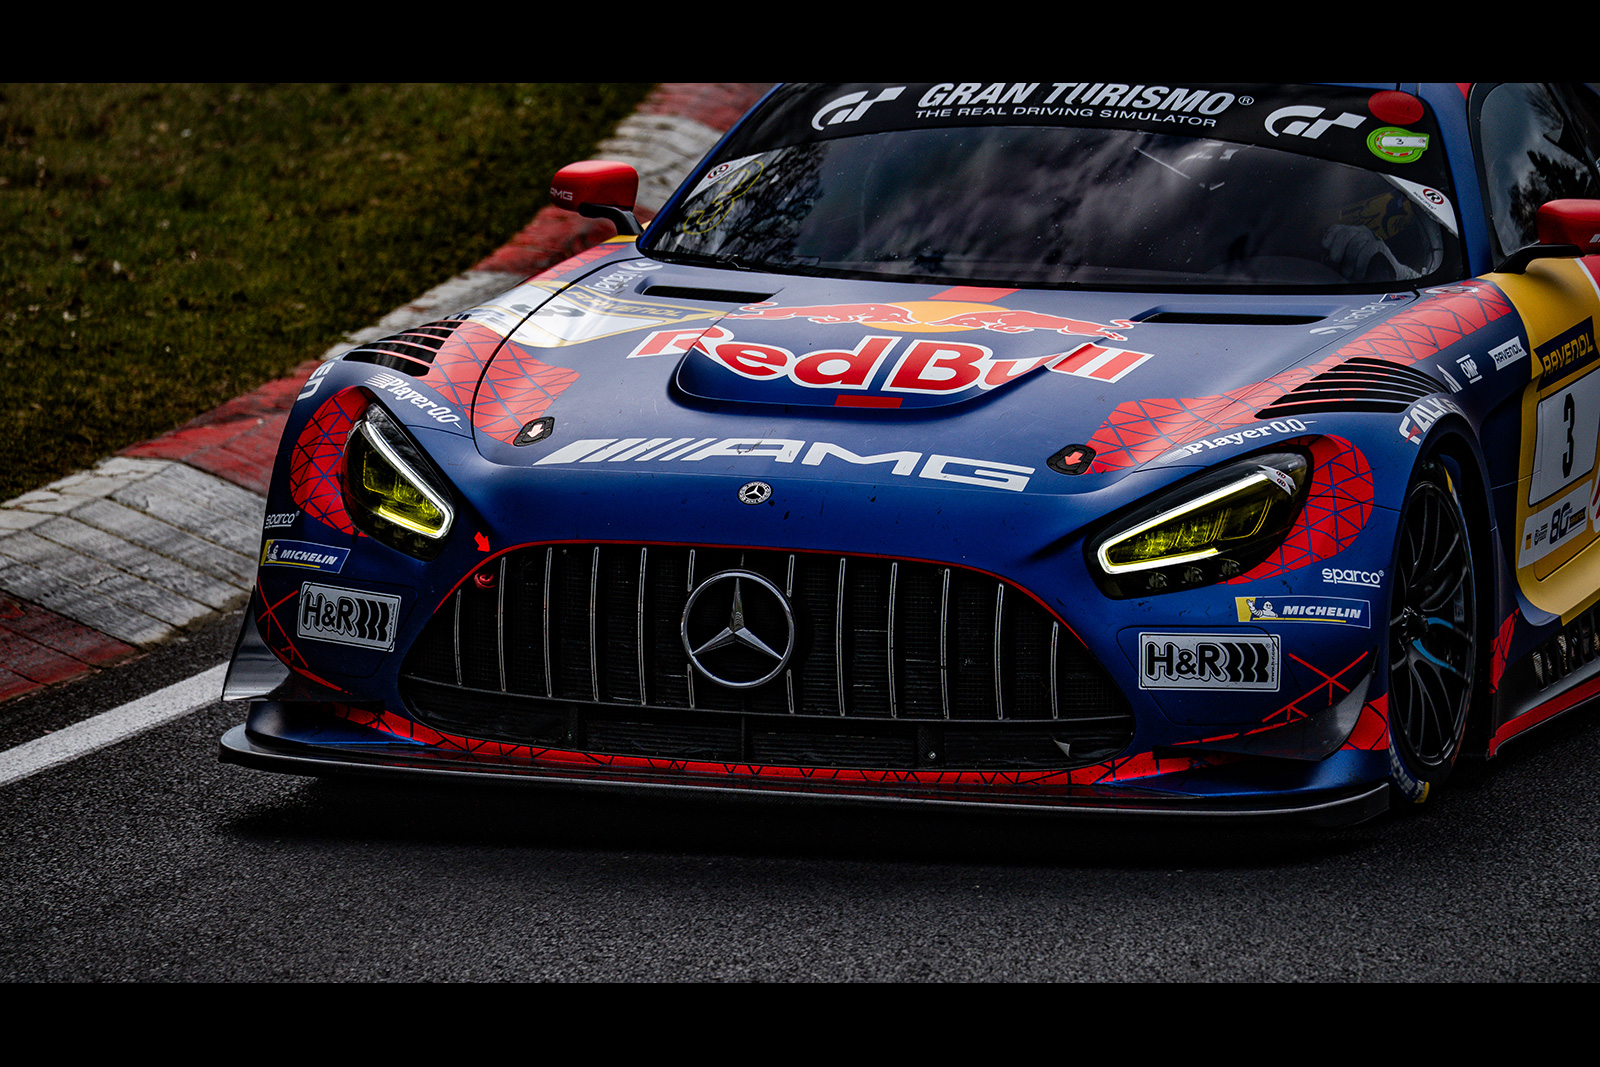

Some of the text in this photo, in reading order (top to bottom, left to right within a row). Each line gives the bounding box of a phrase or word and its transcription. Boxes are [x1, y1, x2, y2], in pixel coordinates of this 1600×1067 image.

[915, 106, 1217, 127] THE REAL DRIVING SIMULATOR
[918, 83, 1235, 115] GRAN TURISMO
[627, 325, 1154, 395] Red Bull
[1460, 358, 1478, 379] OMP
[1494, 343, 1522, 364] RAVENOL
[1542, 332, 1594, 377] RAVENOL
[385, 377, 461, 424] Player 0.0
[1184, 418, 1307, 455] Player 0.0
[1562, 392, 1575, 479] 3
[678, 437, 1035, 493] AMG
[280, 549, 338, 565] MICHELIN
[301, 591, 358, 638] H&R
[1282, 605, 1361, 619] MICHELIN
[1145, 641, 1228, 682] H&R
